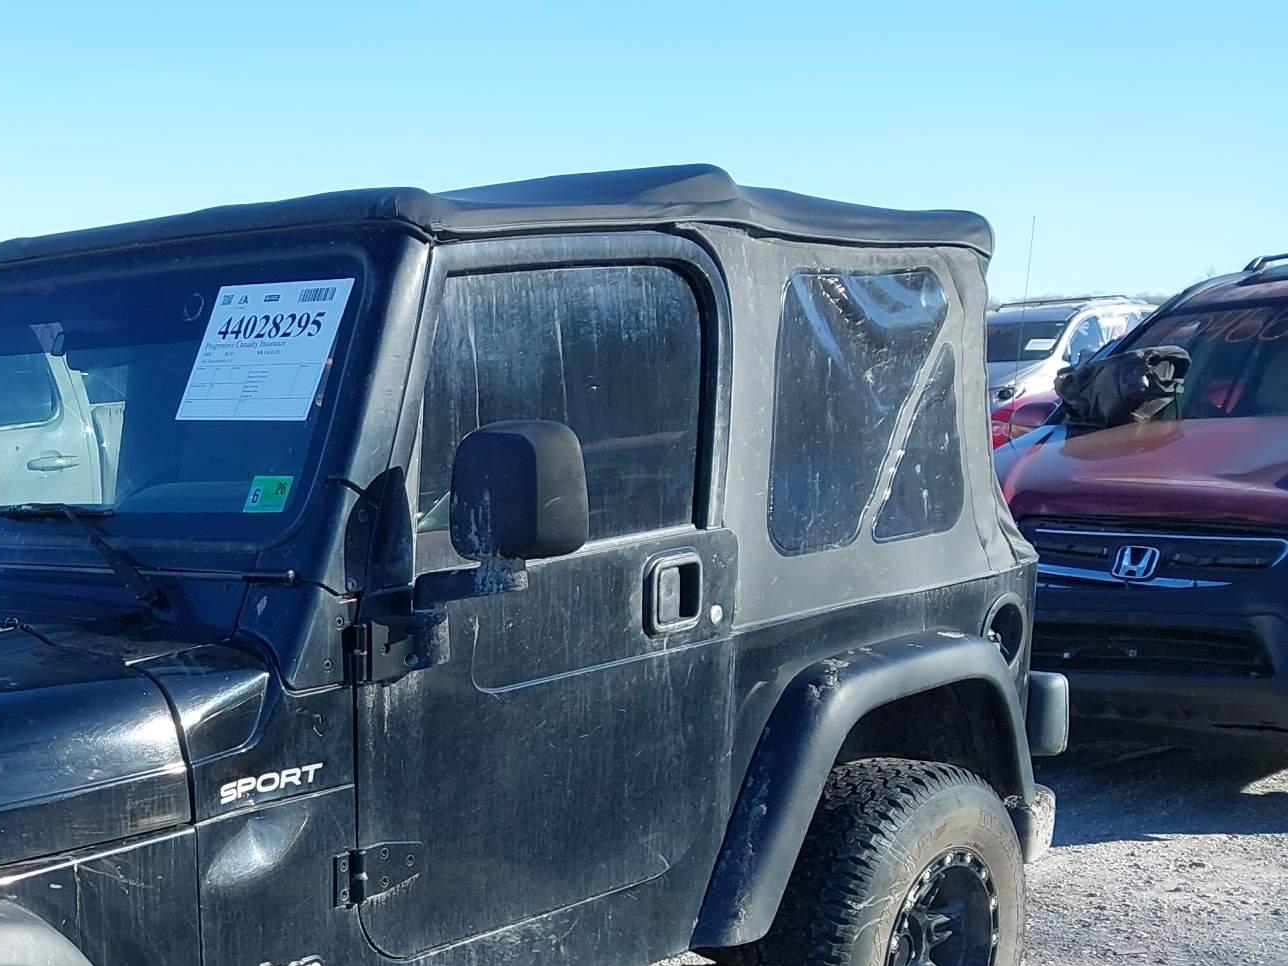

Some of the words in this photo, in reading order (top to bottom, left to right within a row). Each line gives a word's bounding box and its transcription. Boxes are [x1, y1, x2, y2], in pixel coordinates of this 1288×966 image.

[217, 312, 327, 340] 44028295
[251, 488, 261, 504] 6
[220, 762, 323, 805] SPORT
